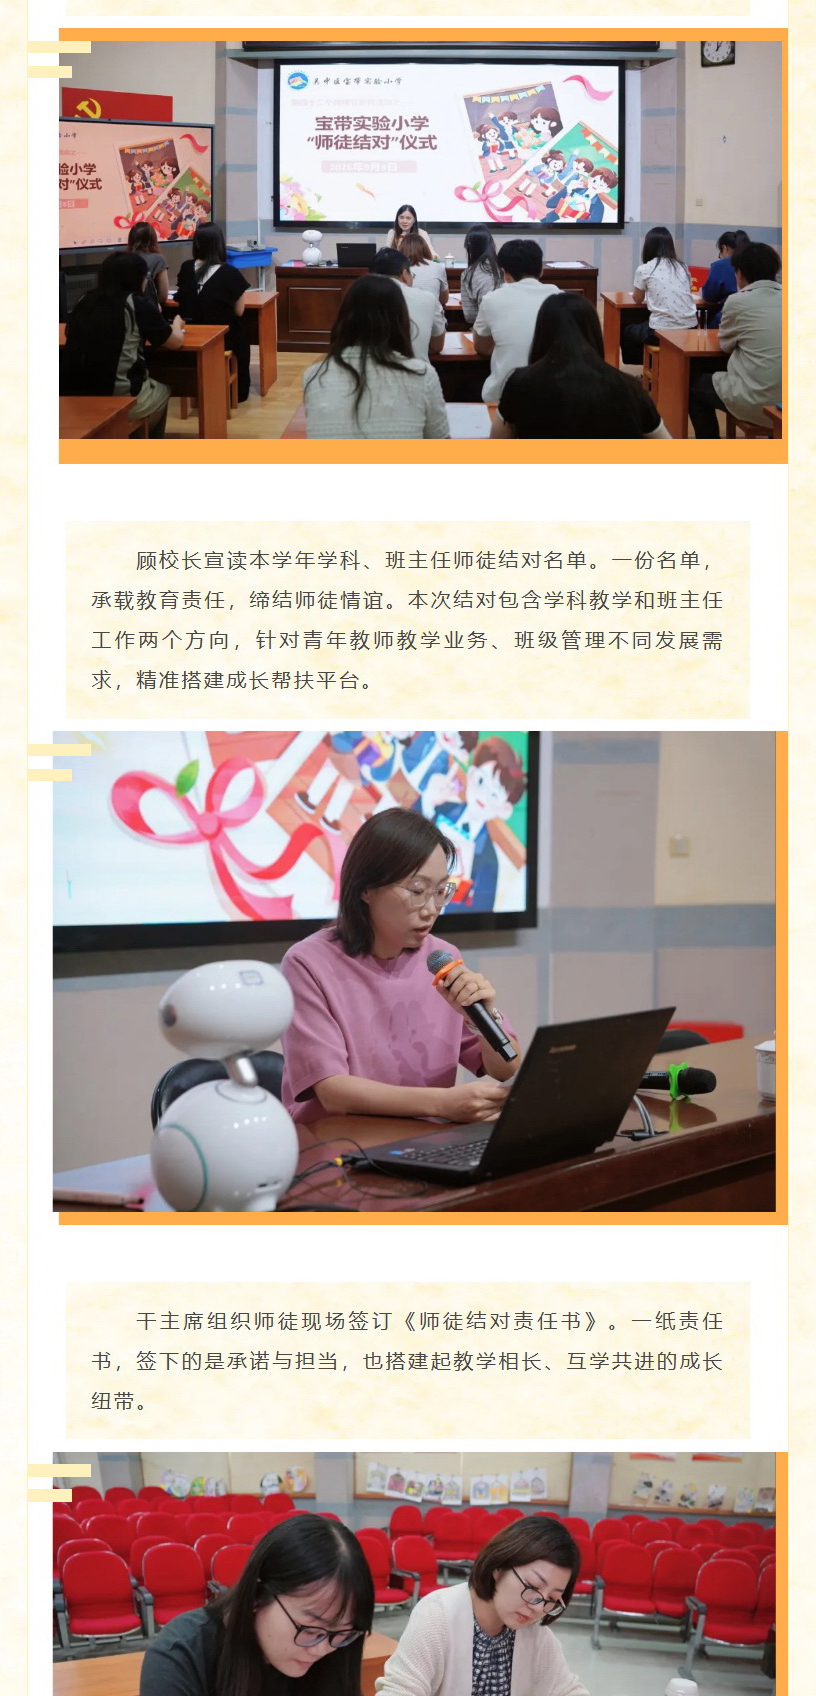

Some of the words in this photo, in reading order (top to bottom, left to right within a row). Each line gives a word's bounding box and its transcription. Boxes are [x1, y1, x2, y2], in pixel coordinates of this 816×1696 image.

[315, 116, 430, 131] 宝带实验小学
[307, 134, 438, 150] “师徒结对”仪式
